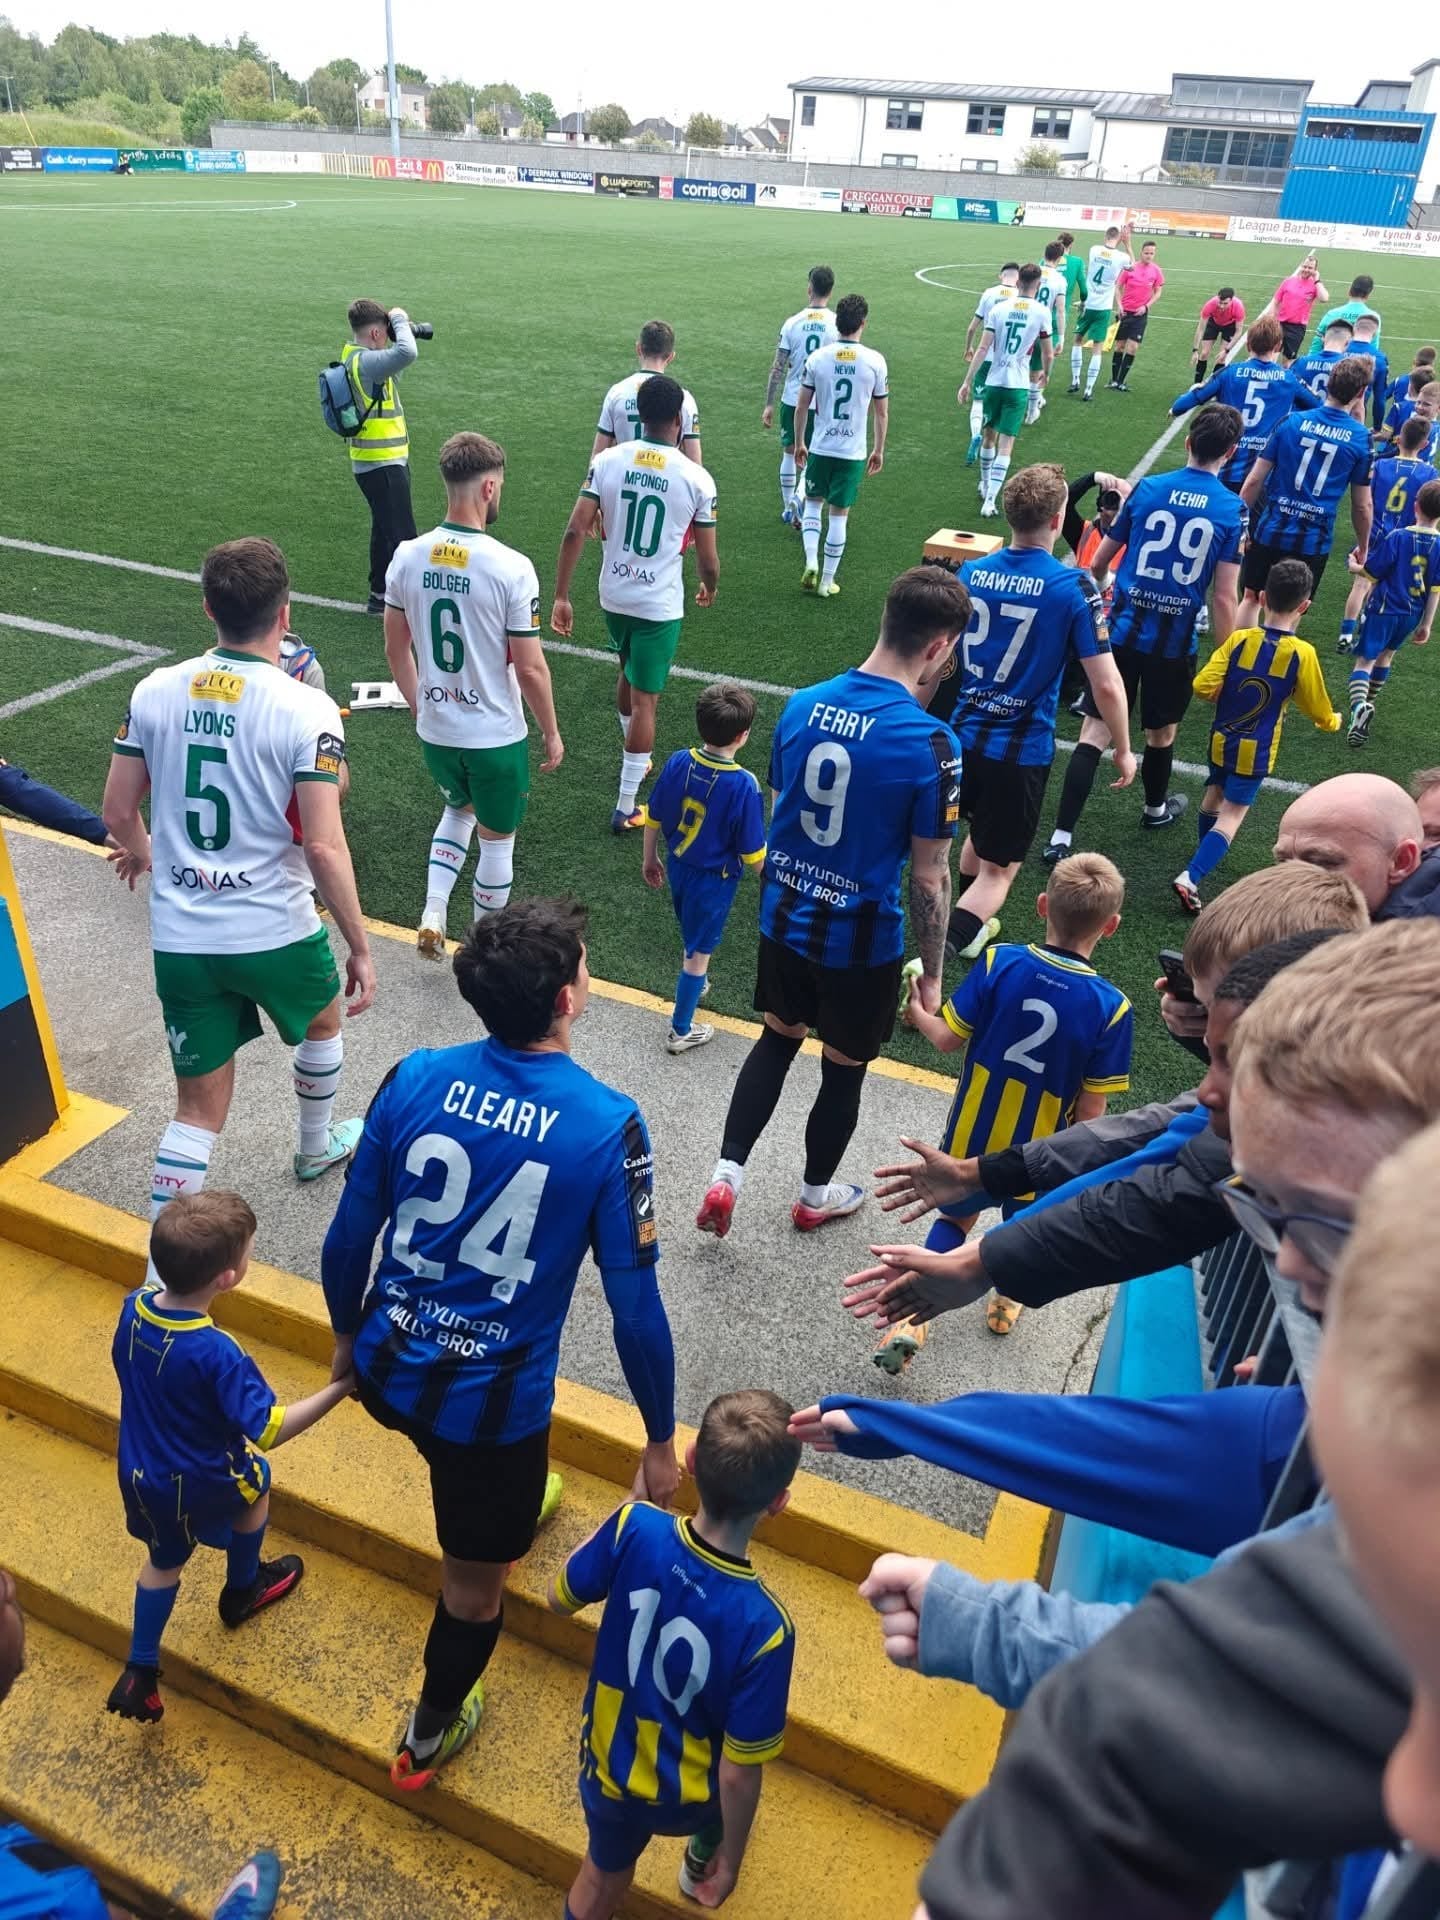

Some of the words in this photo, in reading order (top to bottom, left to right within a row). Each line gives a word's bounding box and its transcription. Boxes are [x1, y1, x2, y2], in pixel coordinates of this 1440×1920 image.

[560, 171, 593, 180] WINDOWS
[845, 191, 893, 203] CREGGAN
[894, 194, 931, 206] COURT
[870, 203, 902, 214] HOTEL
[1238, 218, 1280, 233] League
[1283, 221, 1329, 236] Barbers
[1362, 228, 1380, 238] Joe
[1383, 229, 1412, 240] Lynch
[1414, 231, 1422, 240] &
[1092, 266, 1104, 285] 4
[1005, 321, 1026, 355] 15
[834, 364, 856, 375] NEVIN
[1305, 360, 1333, 371] MALON
[833, 378, 853, 420] 2
[1242, 381, 1269, 427] 5
[825, 427, 854, 438] SONAS
[1300, 419, 1352, 442] McMANUS
[624, 470, 668, 493] MPONGO
[1385, 476, 1408, 513] 6
[1168, 489, 1209, 509] KEHIR
[1291, 500, 1324, 514] HYUNDAI
[621, 489, 666, 558] 10
[1136, 510, 1214, 585] 29
[423, 571, 470, 595] BOLGER
[611, 561, 656, 584] SONAS
[970, 569, 1045, 596] CRAWFORD
[1408, 555, 1427, 596] 3
[1130, 597, 1156, 610] NALLY
[1157, 604, 1183, 616] BROS
[1144, 591, 1192, 607] HYUNDAI
[430, 598, 465, 674] 6
[962, 596, 1038, 683] 27
[208, 673, 242, 692] UCC
[424, 685, 479, 705] SONAS
[977, 688, 1027, 708] HYUNDAI
[988, 702, 1016, 716] BROS
[1221, 676, 1272, 734] 2
[184, 709, 236, 738] LYONS
[807, 702, 877, 741] FERRY
[185, 743, 231, 851] 5
[800, 741, 852, 847] 9
[673, 796, 707, 858] 9
[435, 848, 459, 862] CITY
[171, 865, 253, 893] SONAS
[775, 869, 812, 893] NALLY
[812, 885, 849, 908] BROS
[794, 859, 860, 893] HYUNDAI
[1003, 998, 1058, 1075] 2
[442, 1080, 560, 1143] CLEARY
[153, 1174, 187, 1189] CITY
[392, 1133, 550, 1305] 24
[387, 1304, 432, 1339] NALLY
[436, 1329, 489, 1360] BROS
[418, 1296, 510, 1343] HYUNDAI
[627, 1587, 711, 1717] 10
